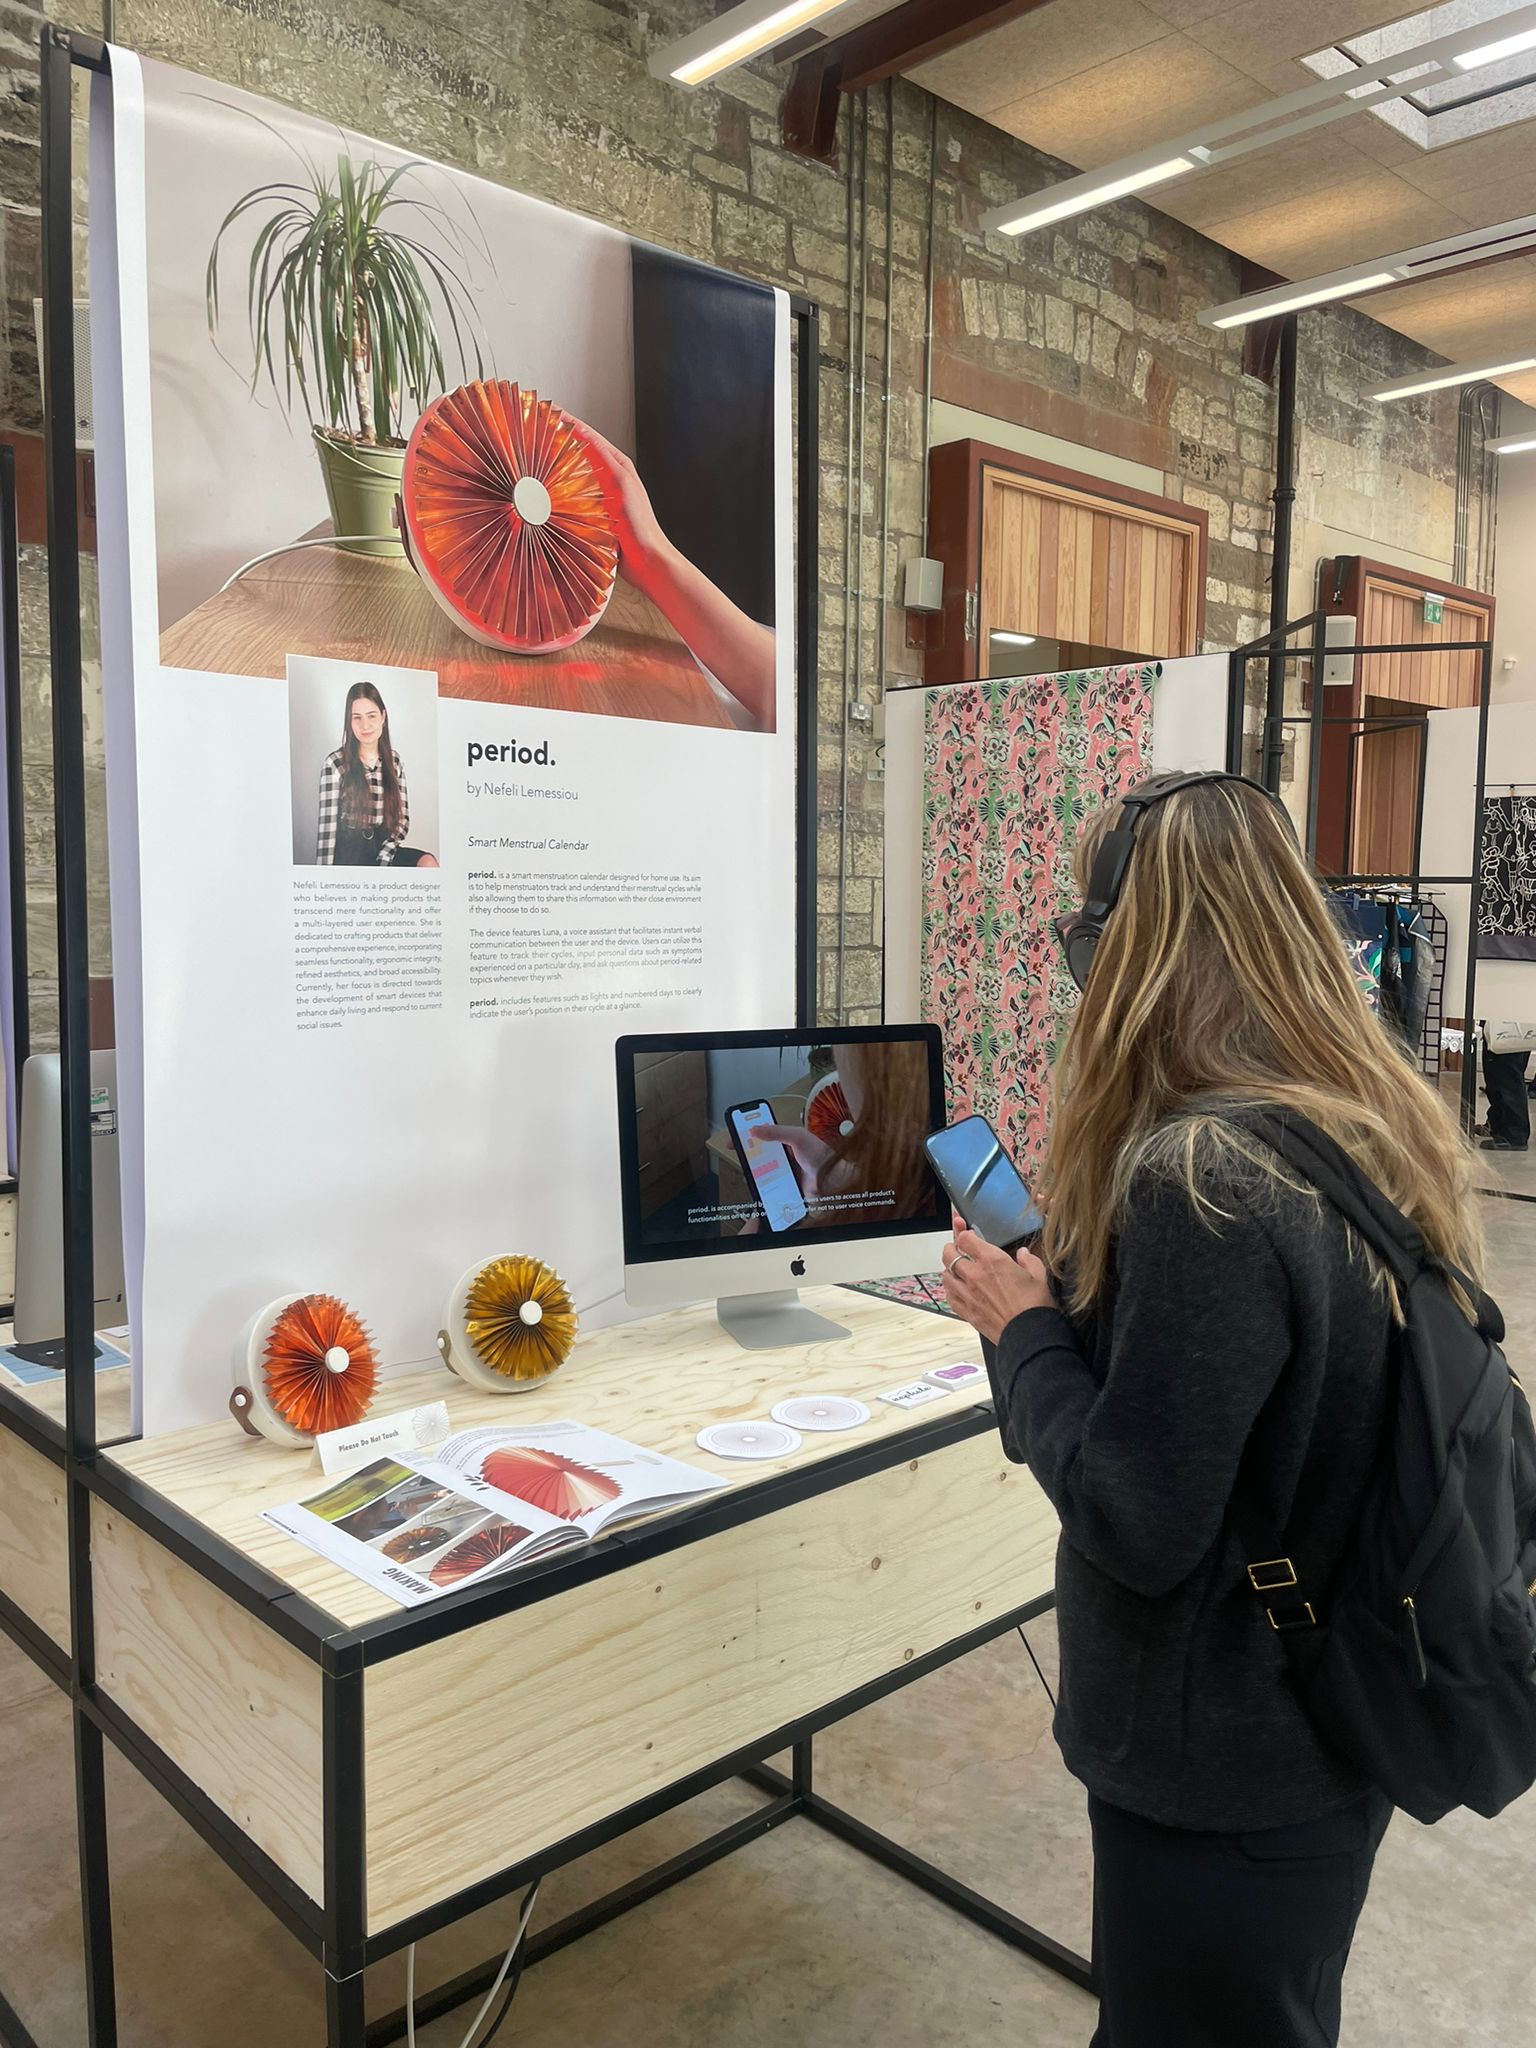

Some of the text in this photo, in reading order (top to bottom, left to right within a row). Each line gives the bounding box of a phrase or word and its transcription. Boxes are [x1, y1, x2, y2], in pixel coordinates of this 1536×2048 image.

[468, 739, 556, 766] period.
[467, 781, 578, 800] by Nefeli Lemessiou
[468, 836, 589, 850] Smart Menstrual Calendar
[469, 870, 497, 880] period.
[533, 872, 578, 880] menstruation
[579, 872, 608, 880] calendar
[609, 873, 639, 882] designed
[641, 873, 649, 881] for
[651, 873, 668, 881] home
[293, 881, 317, 889] Nefeli
[379, 882, 408, 892] product
[410, 882, 440, 892] designer
[485, 882, 502, 892] help
[568, 883, 581, 891] and
[583, 883, 620, 891] understand
[621, 883, 635, 891] their
[636, 883, 667, 891] menstrual
[361, 894, 388, 903] making
[391, 894, 423, 903] products
[485, 894, 516, 903] allowing
[566, 894, 578, 902] this
[579, 894, 617, 902] information
[618, 894, 631, 902] with
[633, 894, 647, 902] their
[359, 906, 405, 916] functionality
[408, 906, 421, 914] and
[469, 905, 474, 913] if
[475, 905, 492, 915] they
[302, 919, 354, 929] multi-layered
[295, 932, 333, 940] dedicated
[343, 932, 371, 941] crafting
[372, 931, 403, 941] products
[404, 931, 418, 939] that
[470, 929, 485, 937] The
[513, 928, 541, 936] features
[618, 927, 631, 935] that
[470, 940, 527, 948] communication
[528, 939, 559, 947] between
[591, 938, 604, 946] and
[301, 944, 355, 955] comprehensive
[398, 943, 442, 953] incorporating
[470, 951, 499, 959] feature
[509, 951, 530, 959] track
[531, 950, 549, 958] their
[296, 958, 328, 966] seamless
[376, 956, 412, 966] ergonomic
[470, 962, 516, 973] experienced
[296, 970, 322, 978] refined
[379, 968, 400, 976] broad
[350, 981, 371, 989] focus
[382, 980, 412, 988] directed
[414, 979, 442, 987] towards
[470, 973, 545, 985] topics whenever they
[296, 996, 309, 1004] the
[310, 993, 363, 1005] development
[365, 993, 373, 1001] of
[398, 991, 426, 999] devices
[428, 990, 442, 998] that
[470, 997, 499, 1008] period.
[297, 1008, 328, 1017] enhance
[329, 1007, 346, 1017] daily
[347, 1006, 366, 1016] living
[368, 1005, 381, 1013] and
[382, 1003, 409, 1014] respond
[419, 1002, 442, 1010] current
[297, 1021, 318, 1029] social
[688, 1207, 710, 1215] period.
[717, 1202, 757, 1211] accompanied
[688, 1214, 730, 1223] functionalities
[339, 1443, 359, 1452] Please
[370, 1435, 381, 1443] Not
[382, 1430, 399, 1440] Touch
[382, 1567, 433, 1594] MAKING
